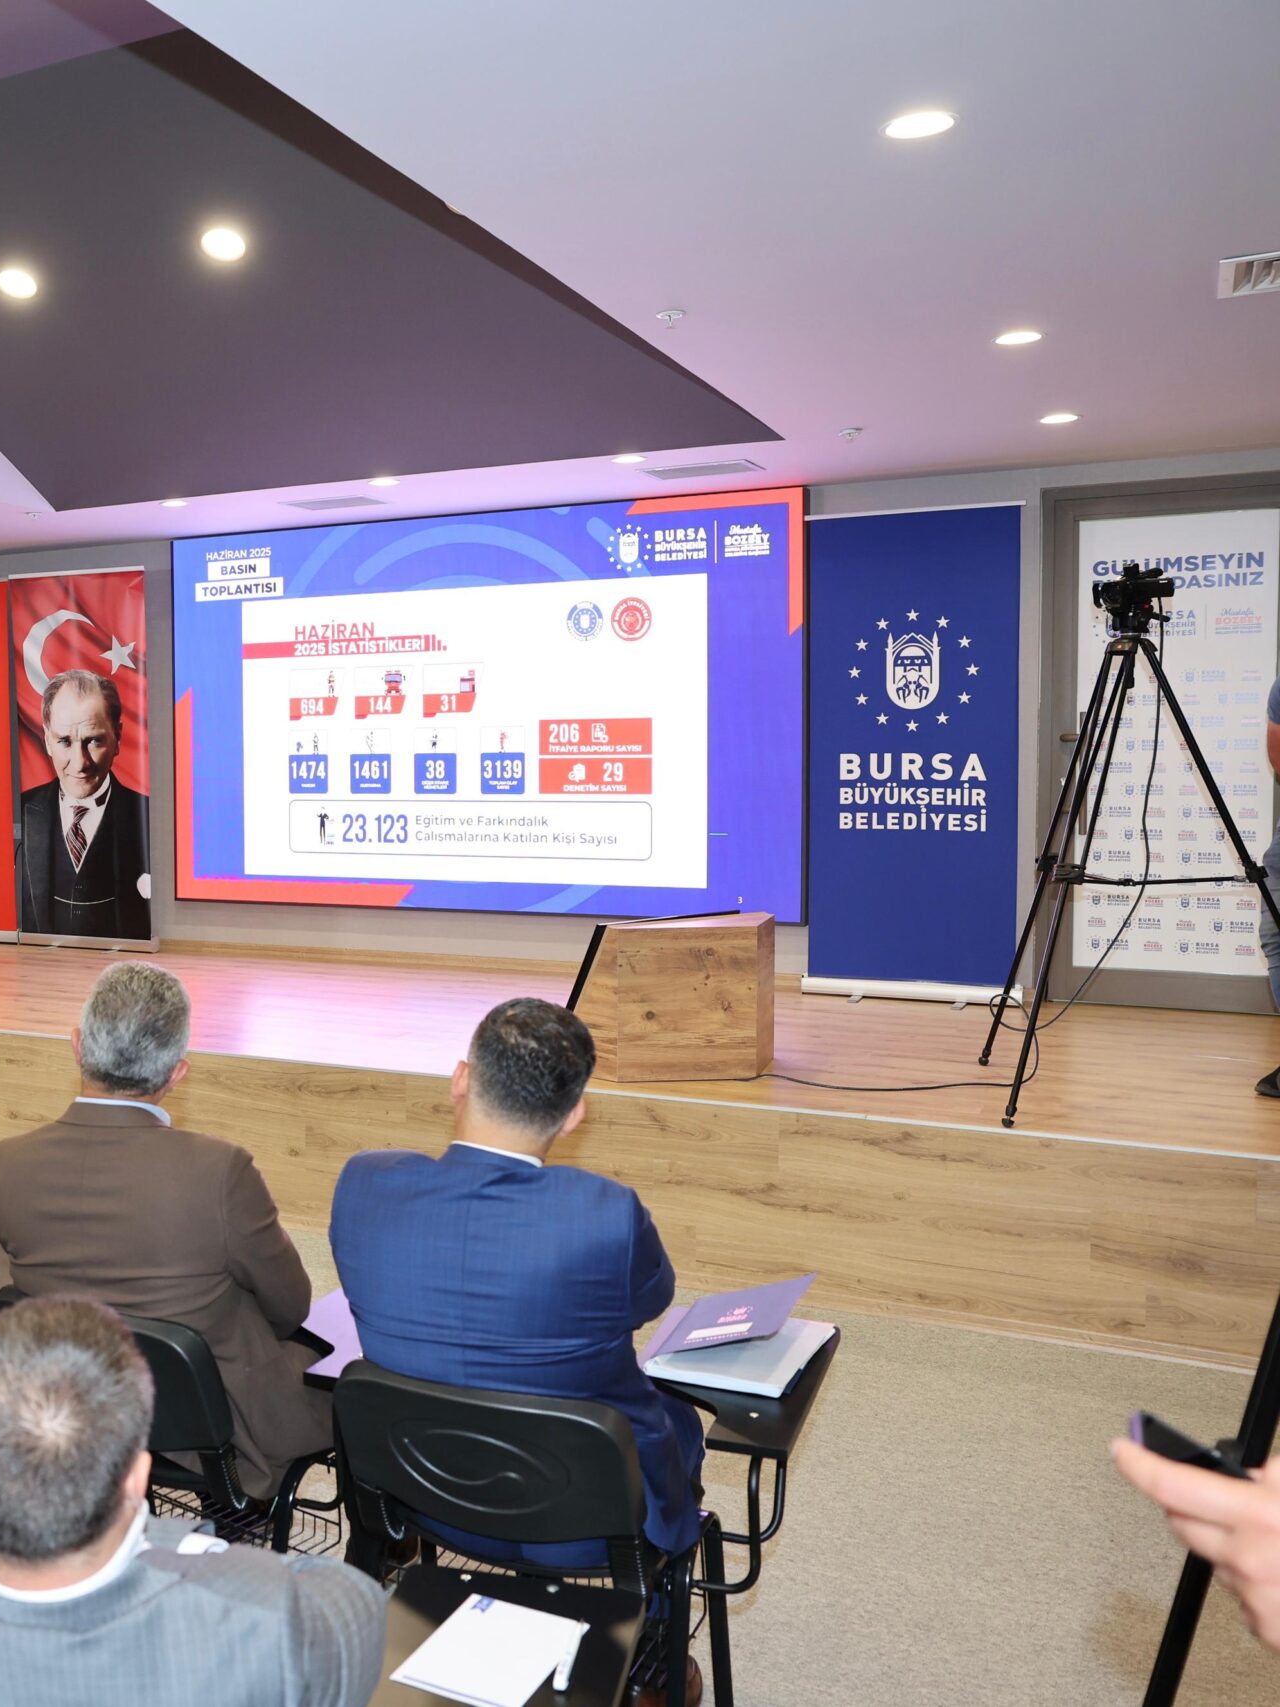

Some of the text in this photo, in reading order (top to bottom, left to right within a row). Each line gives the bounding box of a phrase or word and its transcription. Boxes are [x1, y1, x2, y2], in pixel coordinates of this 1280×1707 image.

[654, 527, 706, 542] BURSA
[206, 548, 271, 560] HAZİRAN 2025
[221, 564, 256, 575] BASIN
[202, 582, 276, 597] TOPLANTISI
[295, 620, 374, 640] HAZİRAN
[294, 636, 425, 656] 2025 İSTATİSTİKLERİ
[300, 699, 324, 714] 694
[369, 697, 392, 712] 144
[441, 695, 456, 711] 31
[549, 724, 579, 743] 206
[291, 761, 326, 779] 1474
[354, 761, 388, 779] 1461
[426, 760, 445, 779] 38
[484, 760, 522, 779] 3139
[603, 762, 623, 782] 29
[840, 752, 987, 781] BURSA
[563, 783, 599, 791] DENETİM
[840, 782, 986, 808] BÜYÜKŞEHİR
[342, 814, 408, 844] 23.123
[460, 818, 473, 826] ve
[477, 816, 549, 827] Farkındalık
[840, 808, 986, 832] BELEDİYESİ
[504, 832, 548, 843] Katılan
[553, 832, 575, 845] Kişi
[579, 833, 617, 847] Sayısı
[738, 896, 743, 904] 3
